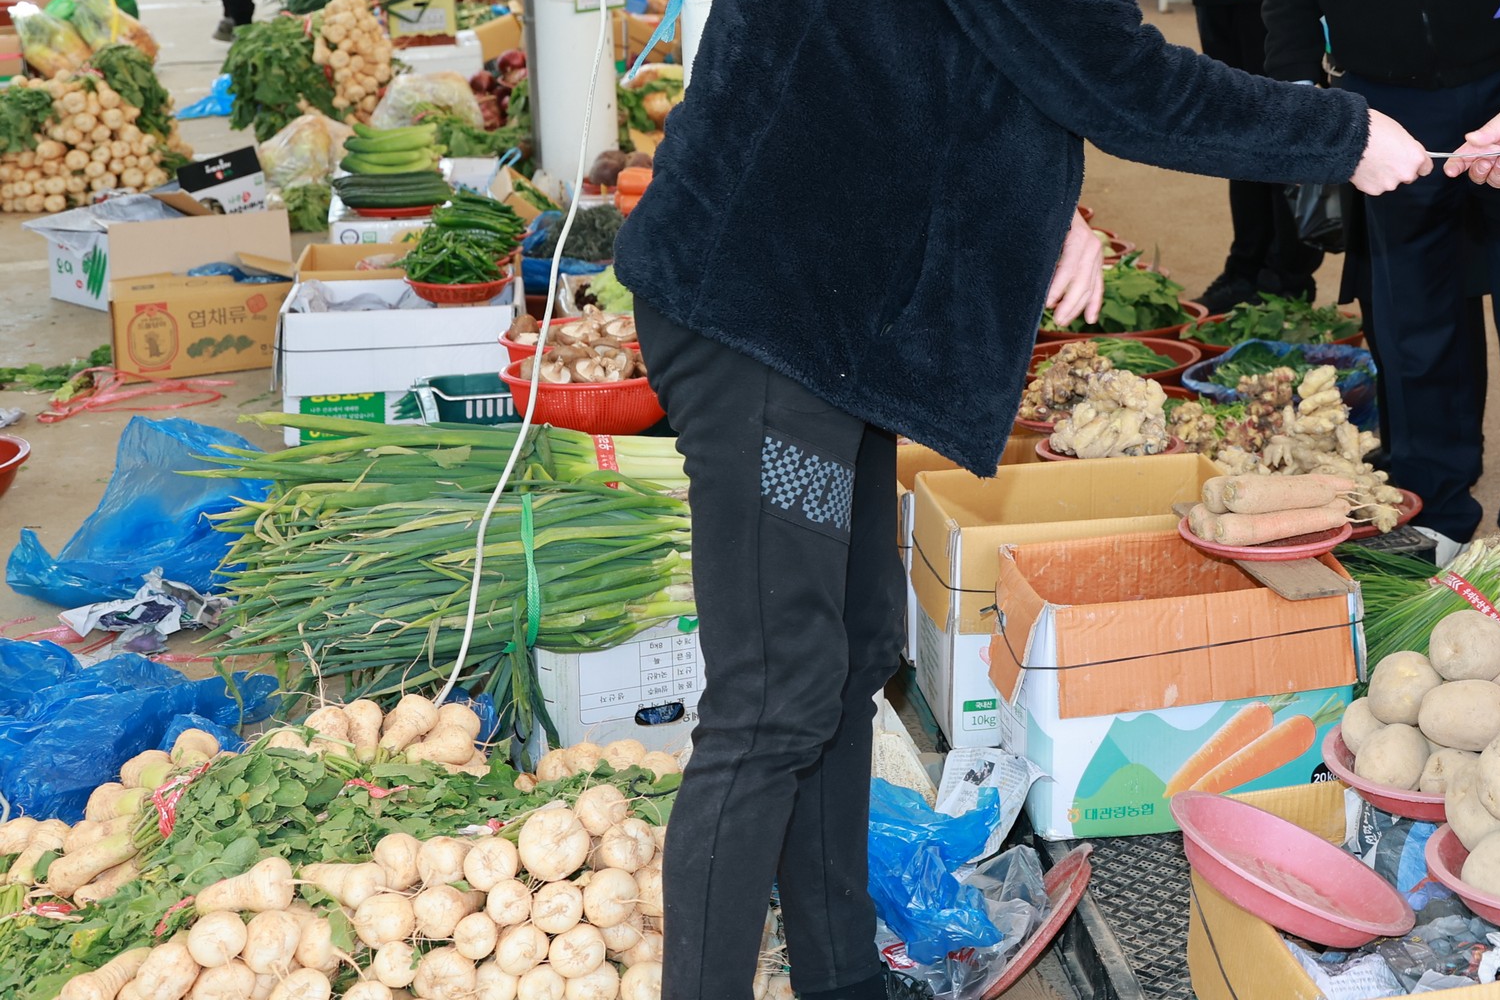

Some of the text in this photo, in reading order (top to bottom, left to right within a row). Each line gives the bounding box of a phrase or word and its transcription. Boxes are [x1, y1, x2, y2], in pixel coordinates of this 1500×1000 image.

[188, 305, 248, 329] 엽채류
[1461, 587, 1491, 615] 우리농산물
[646, 671, 668, 681] 국내산
[975, 701, 993, 709] 국내산
[972, 714, 997, 726] 10kg
[1084, 802, 1155, 821] 대관령농협
